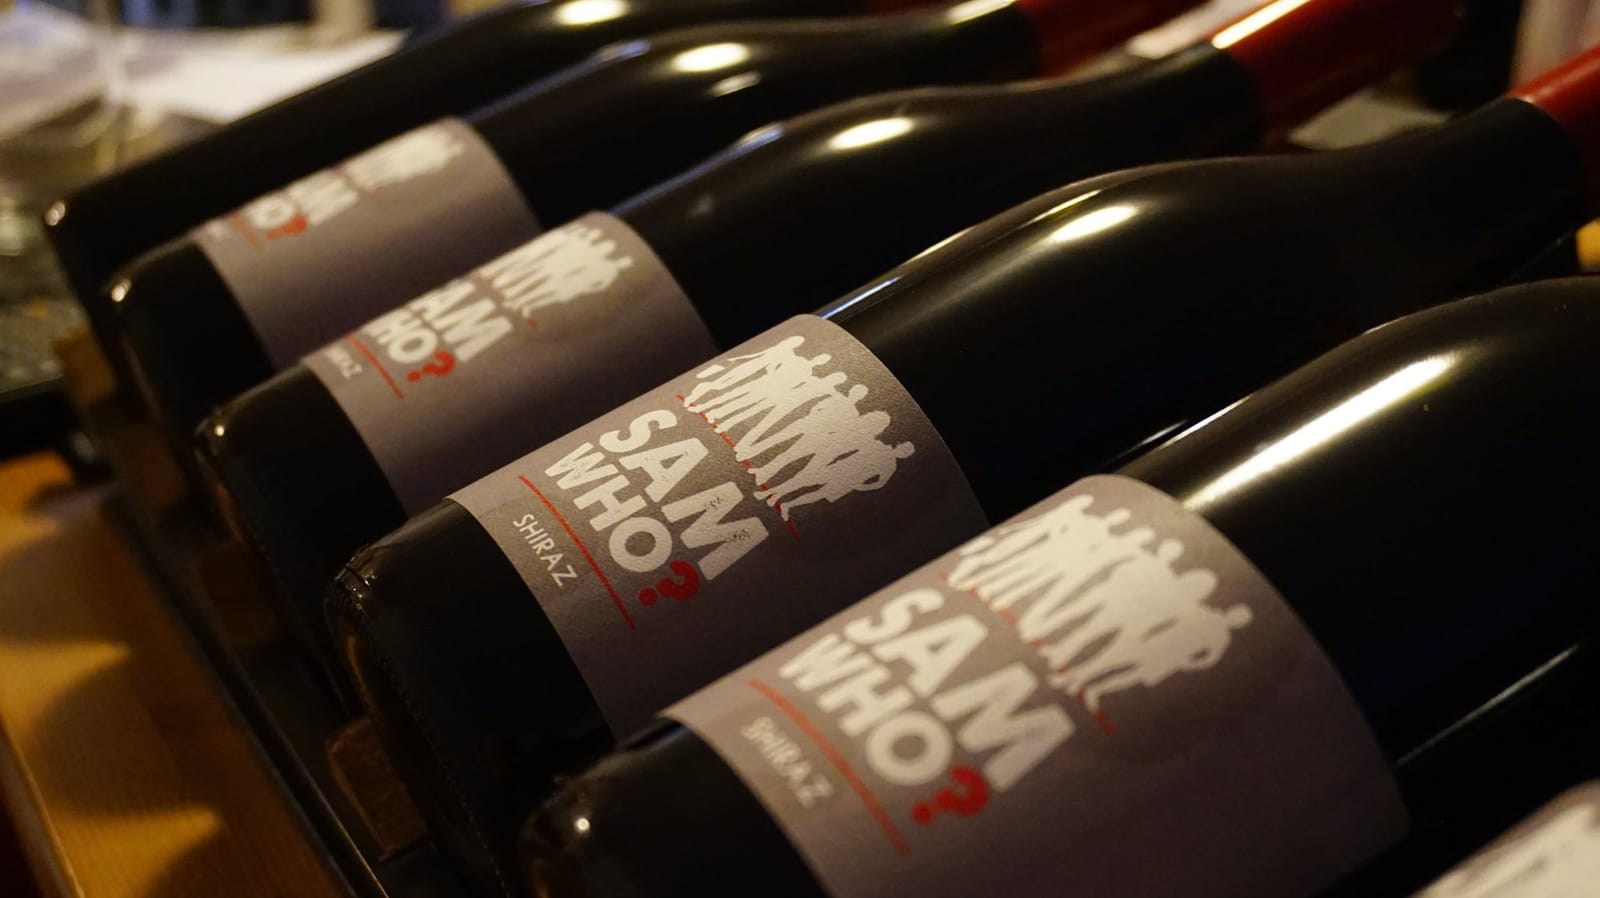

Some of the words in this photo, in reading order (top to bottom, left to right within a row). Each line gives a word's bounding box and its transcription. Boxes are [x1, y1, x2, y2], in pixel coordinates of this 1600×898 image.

[409, 280, 512, 362] AM
[512, 513, 577, 587] SHIRAZ
[544, 442, 700, 606] WHO?
[599, 409, 769, 581] SAM
[740, 716, 834, 808] SHIRAZ
[778, 633, 990, 825] WHO?
[846, 588, 1076, 792] SAM
